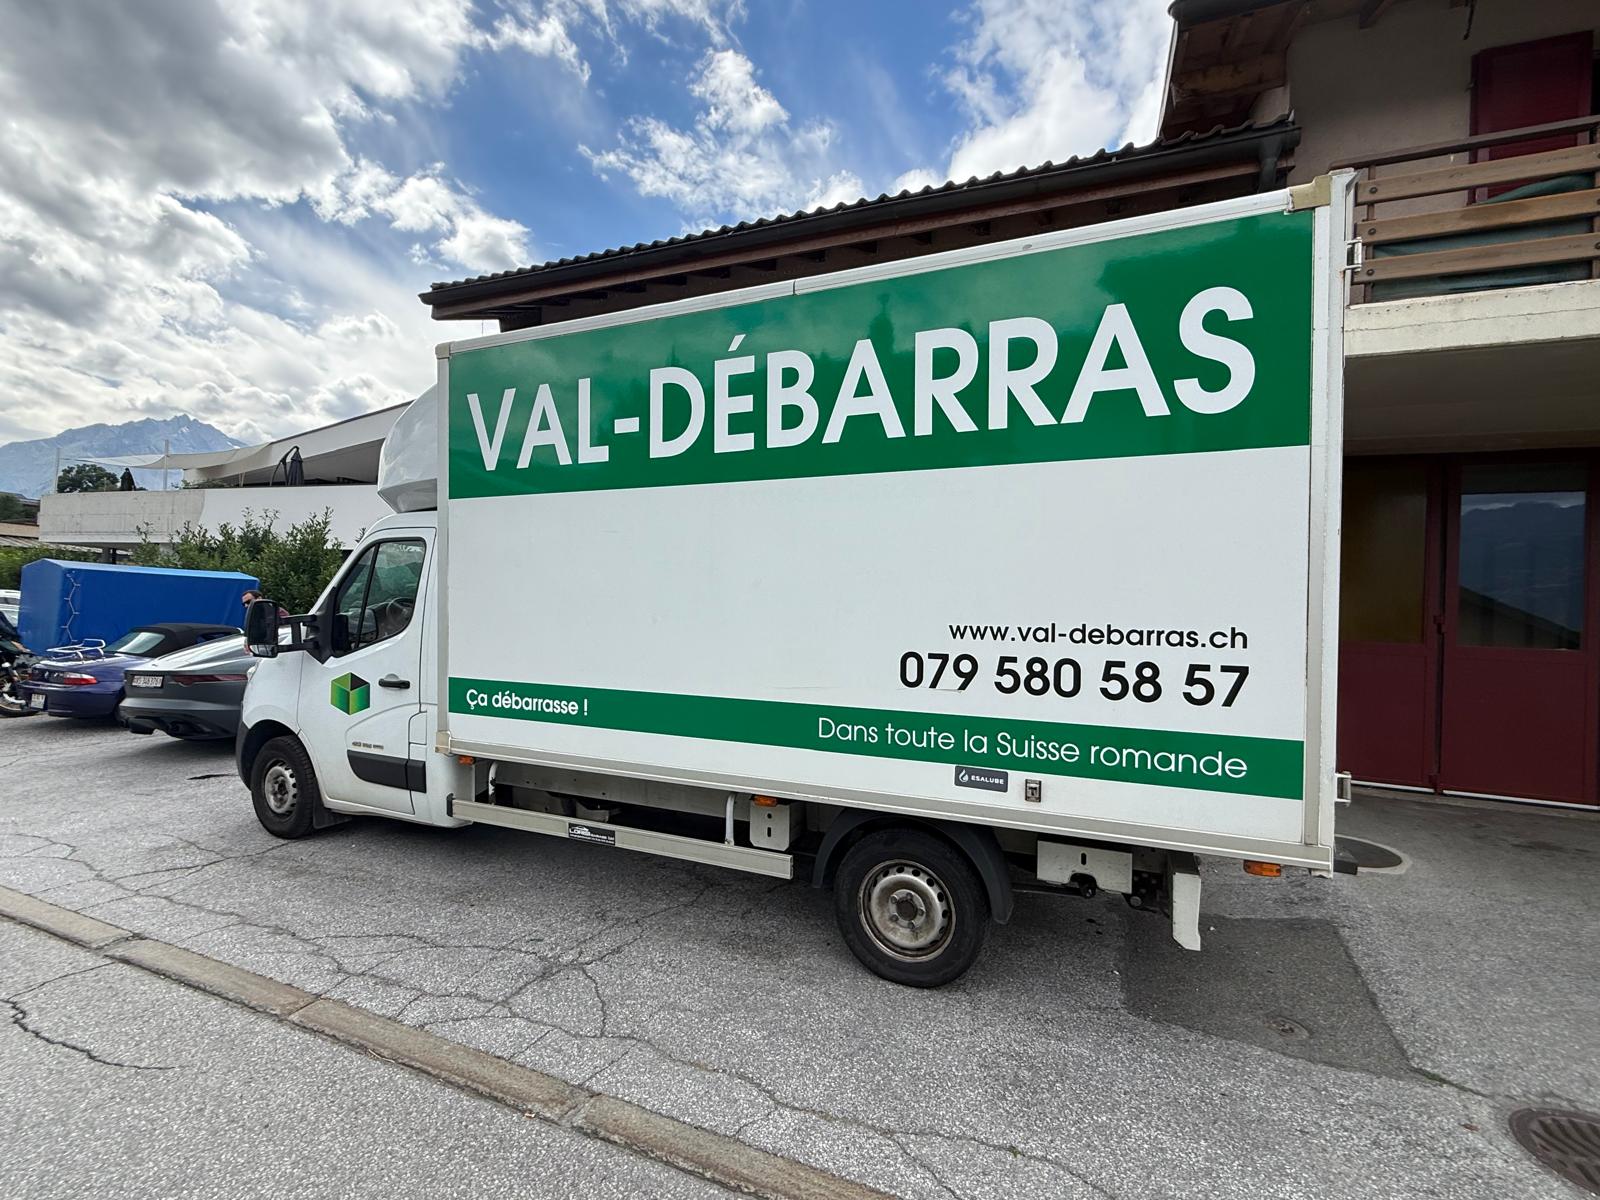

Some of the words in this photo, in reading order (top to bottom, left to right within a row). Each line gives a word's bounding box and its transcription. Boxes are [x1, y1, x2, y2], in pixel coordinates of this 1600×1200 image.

[466, 286, 1256, 471] VAL-DÉBARRAS
[948, 622, 1248, 649] www.val-debarras.ch
[899, 651, 979, 691] 079
[994, 655, 1082, 698] 580
[1099, 660, 1163, 703] 58
[1182, 663, 1250, 708] 57
[466, 688, 488, 710] Ça
[491, 690, 579, 715] débarrasse
[583, 698, 589, 716] !
[818, 717, 879, 743] Dans
[884, 722, 955, 750] toute
[964, 729, 988, 754] la
[996, 731, 1080, 763] Suisse
[1090, 745, 1248, 779] romande
[970, 774, 1005, 785] ESALUBE
